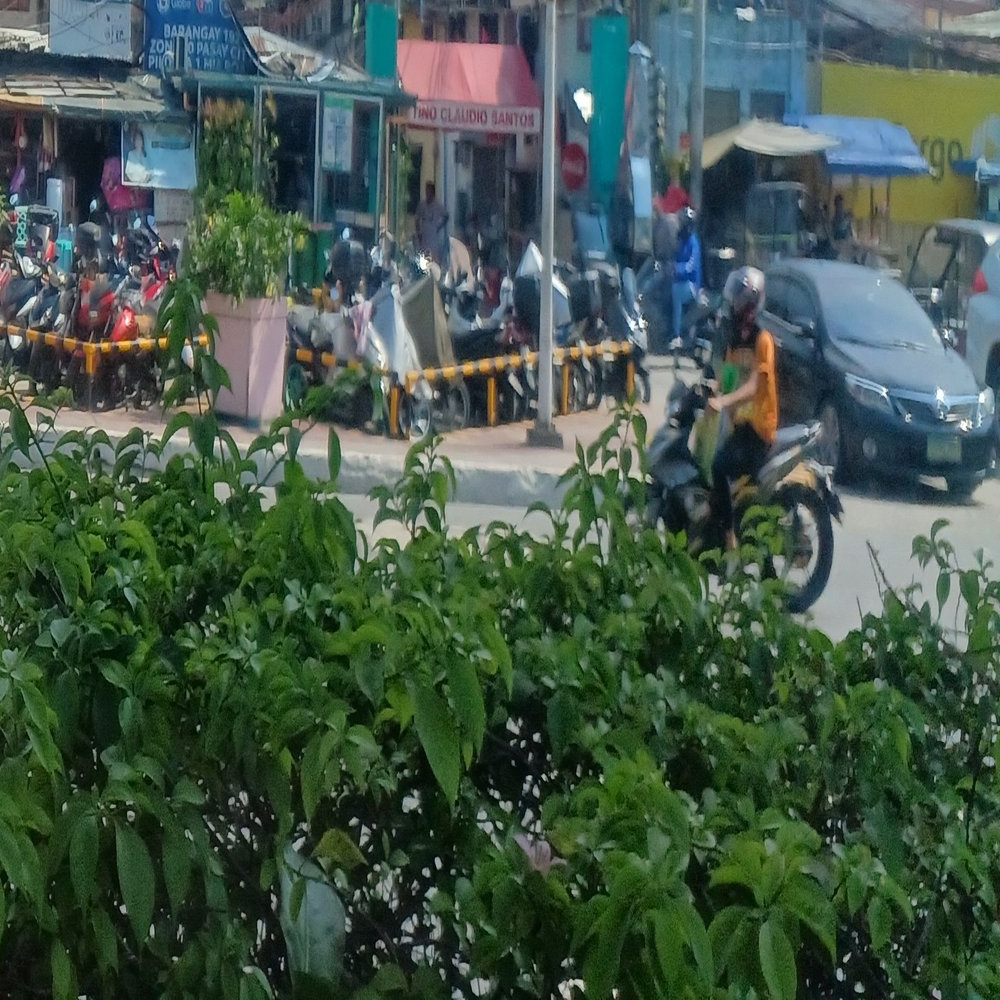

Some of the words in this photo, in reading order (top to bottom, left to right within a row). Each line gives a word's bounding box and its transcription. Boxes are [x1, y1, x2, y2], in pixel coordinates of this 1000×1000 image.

[164, 24, 220, 40] BARANGAY
[149, 39, 175, 54] ZON
[197, 42, 229, 58] PASAY
[440, 107, 488, 124] CLAUDIO
[492, 110, 535, 127] SANTOS
